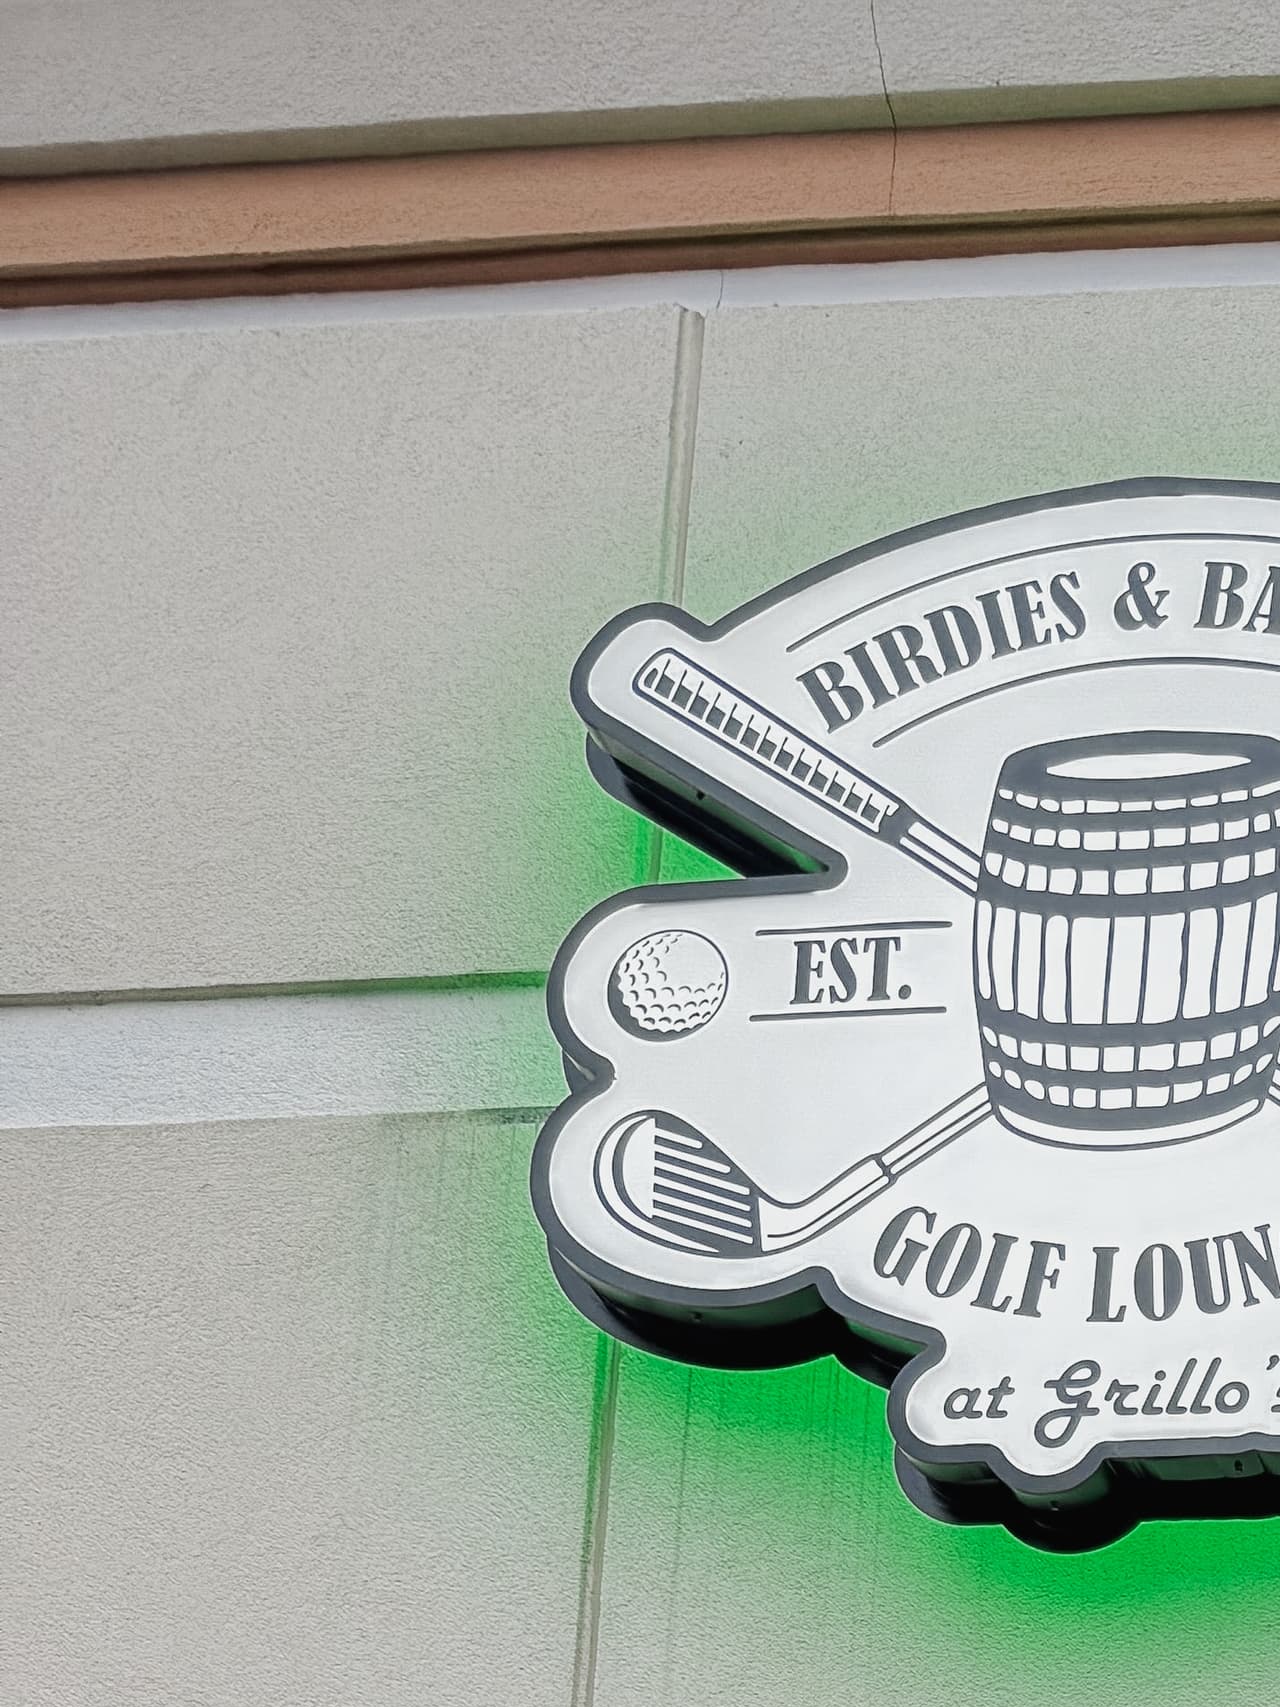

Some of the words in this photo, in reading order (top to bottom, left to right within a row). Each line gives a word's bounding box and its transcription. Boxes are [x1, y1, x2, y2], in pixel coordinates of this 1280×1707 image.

[795, 569, 1091, 734] BIRDIES
[1113, 560, 1170, 628] &
[789, 934, 913, 1006] EST.
[873, 1204, 1067, 1320] GOLF
[943, 1367, 1011, 1422] at
